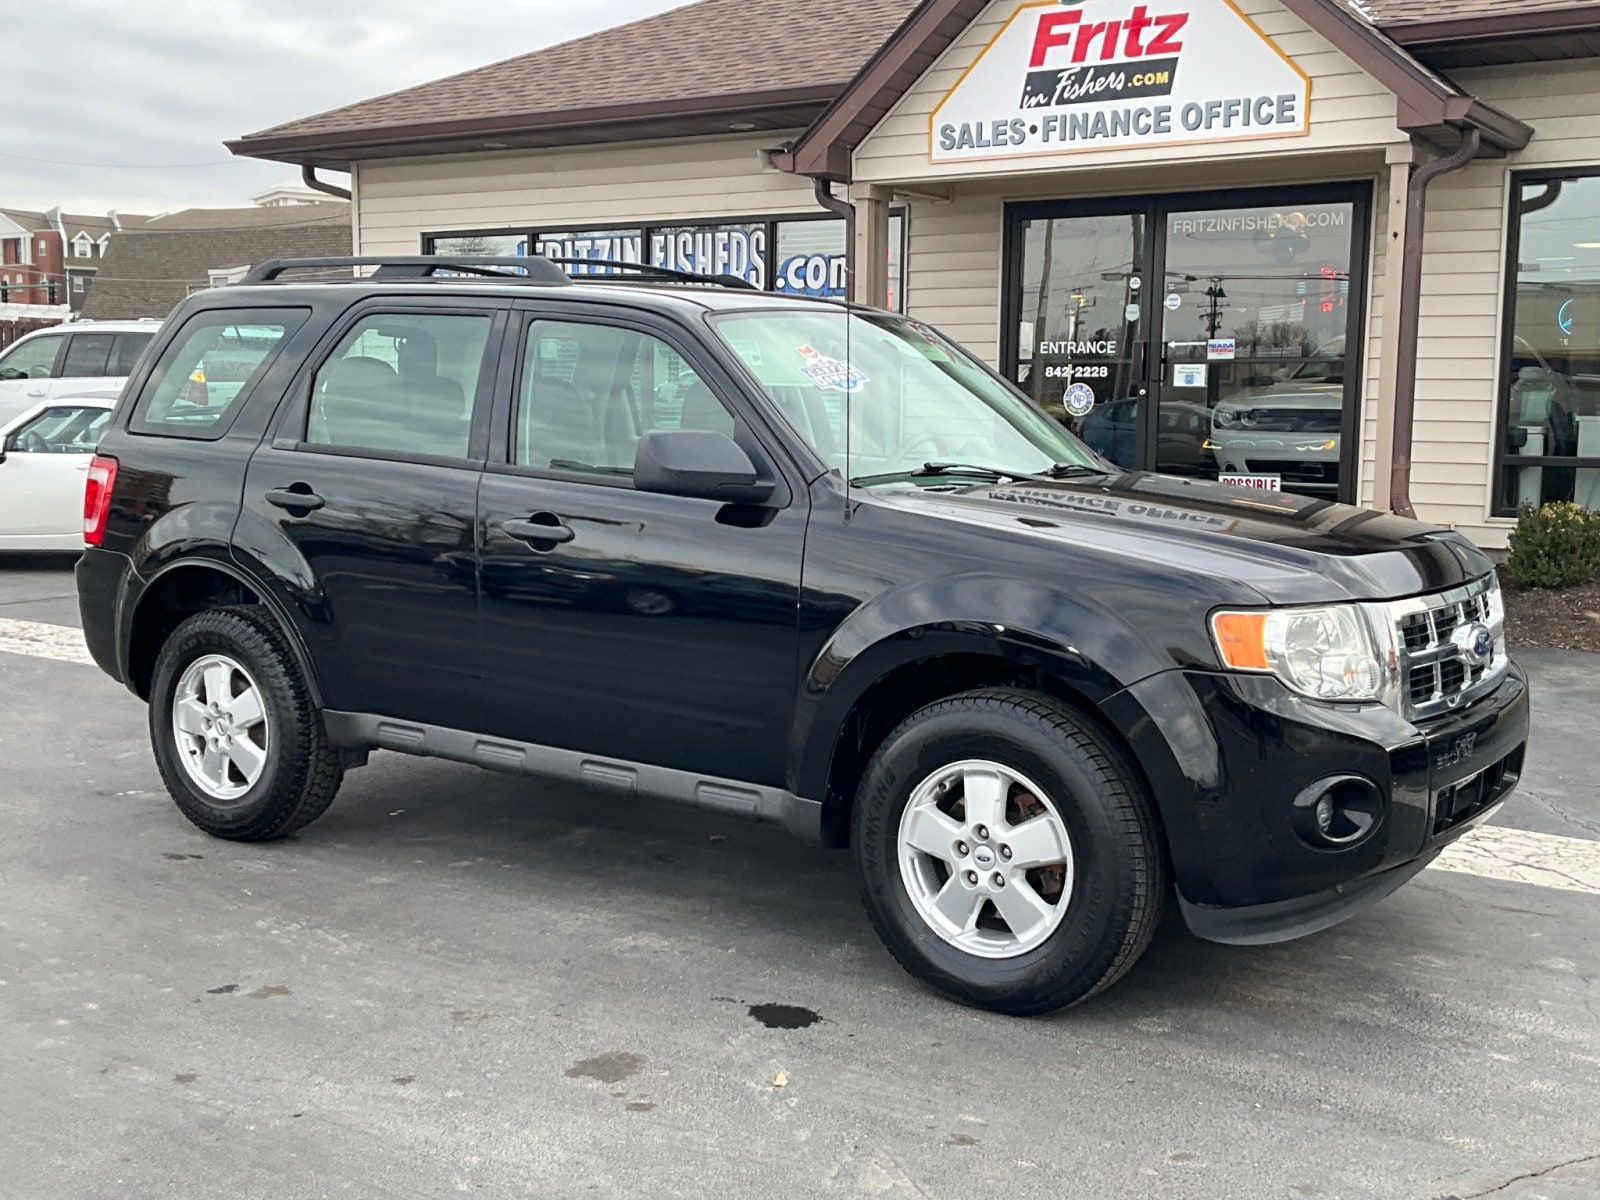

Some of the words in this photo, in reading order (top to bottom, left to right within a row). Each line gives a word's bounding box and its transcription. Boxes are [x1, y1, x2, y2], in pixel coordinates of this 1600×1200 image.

[1029, 5, 1190, 68] Fritz
[1023, 85, 1049, 109] in
[1050, 67, 1126, 107] Fishers
[939, 117, 1025, 151] SALES
[1041, 105, 1172, 142] FINANCE
[1181, 94, 1297, 130] OFFICE
[1172, 211, 1345, 234] FRITZINFISHERS.COM
[1039, 340, 1117, 355] ENTRANCE
[1045, 365, 1109, 378] 842-2228
